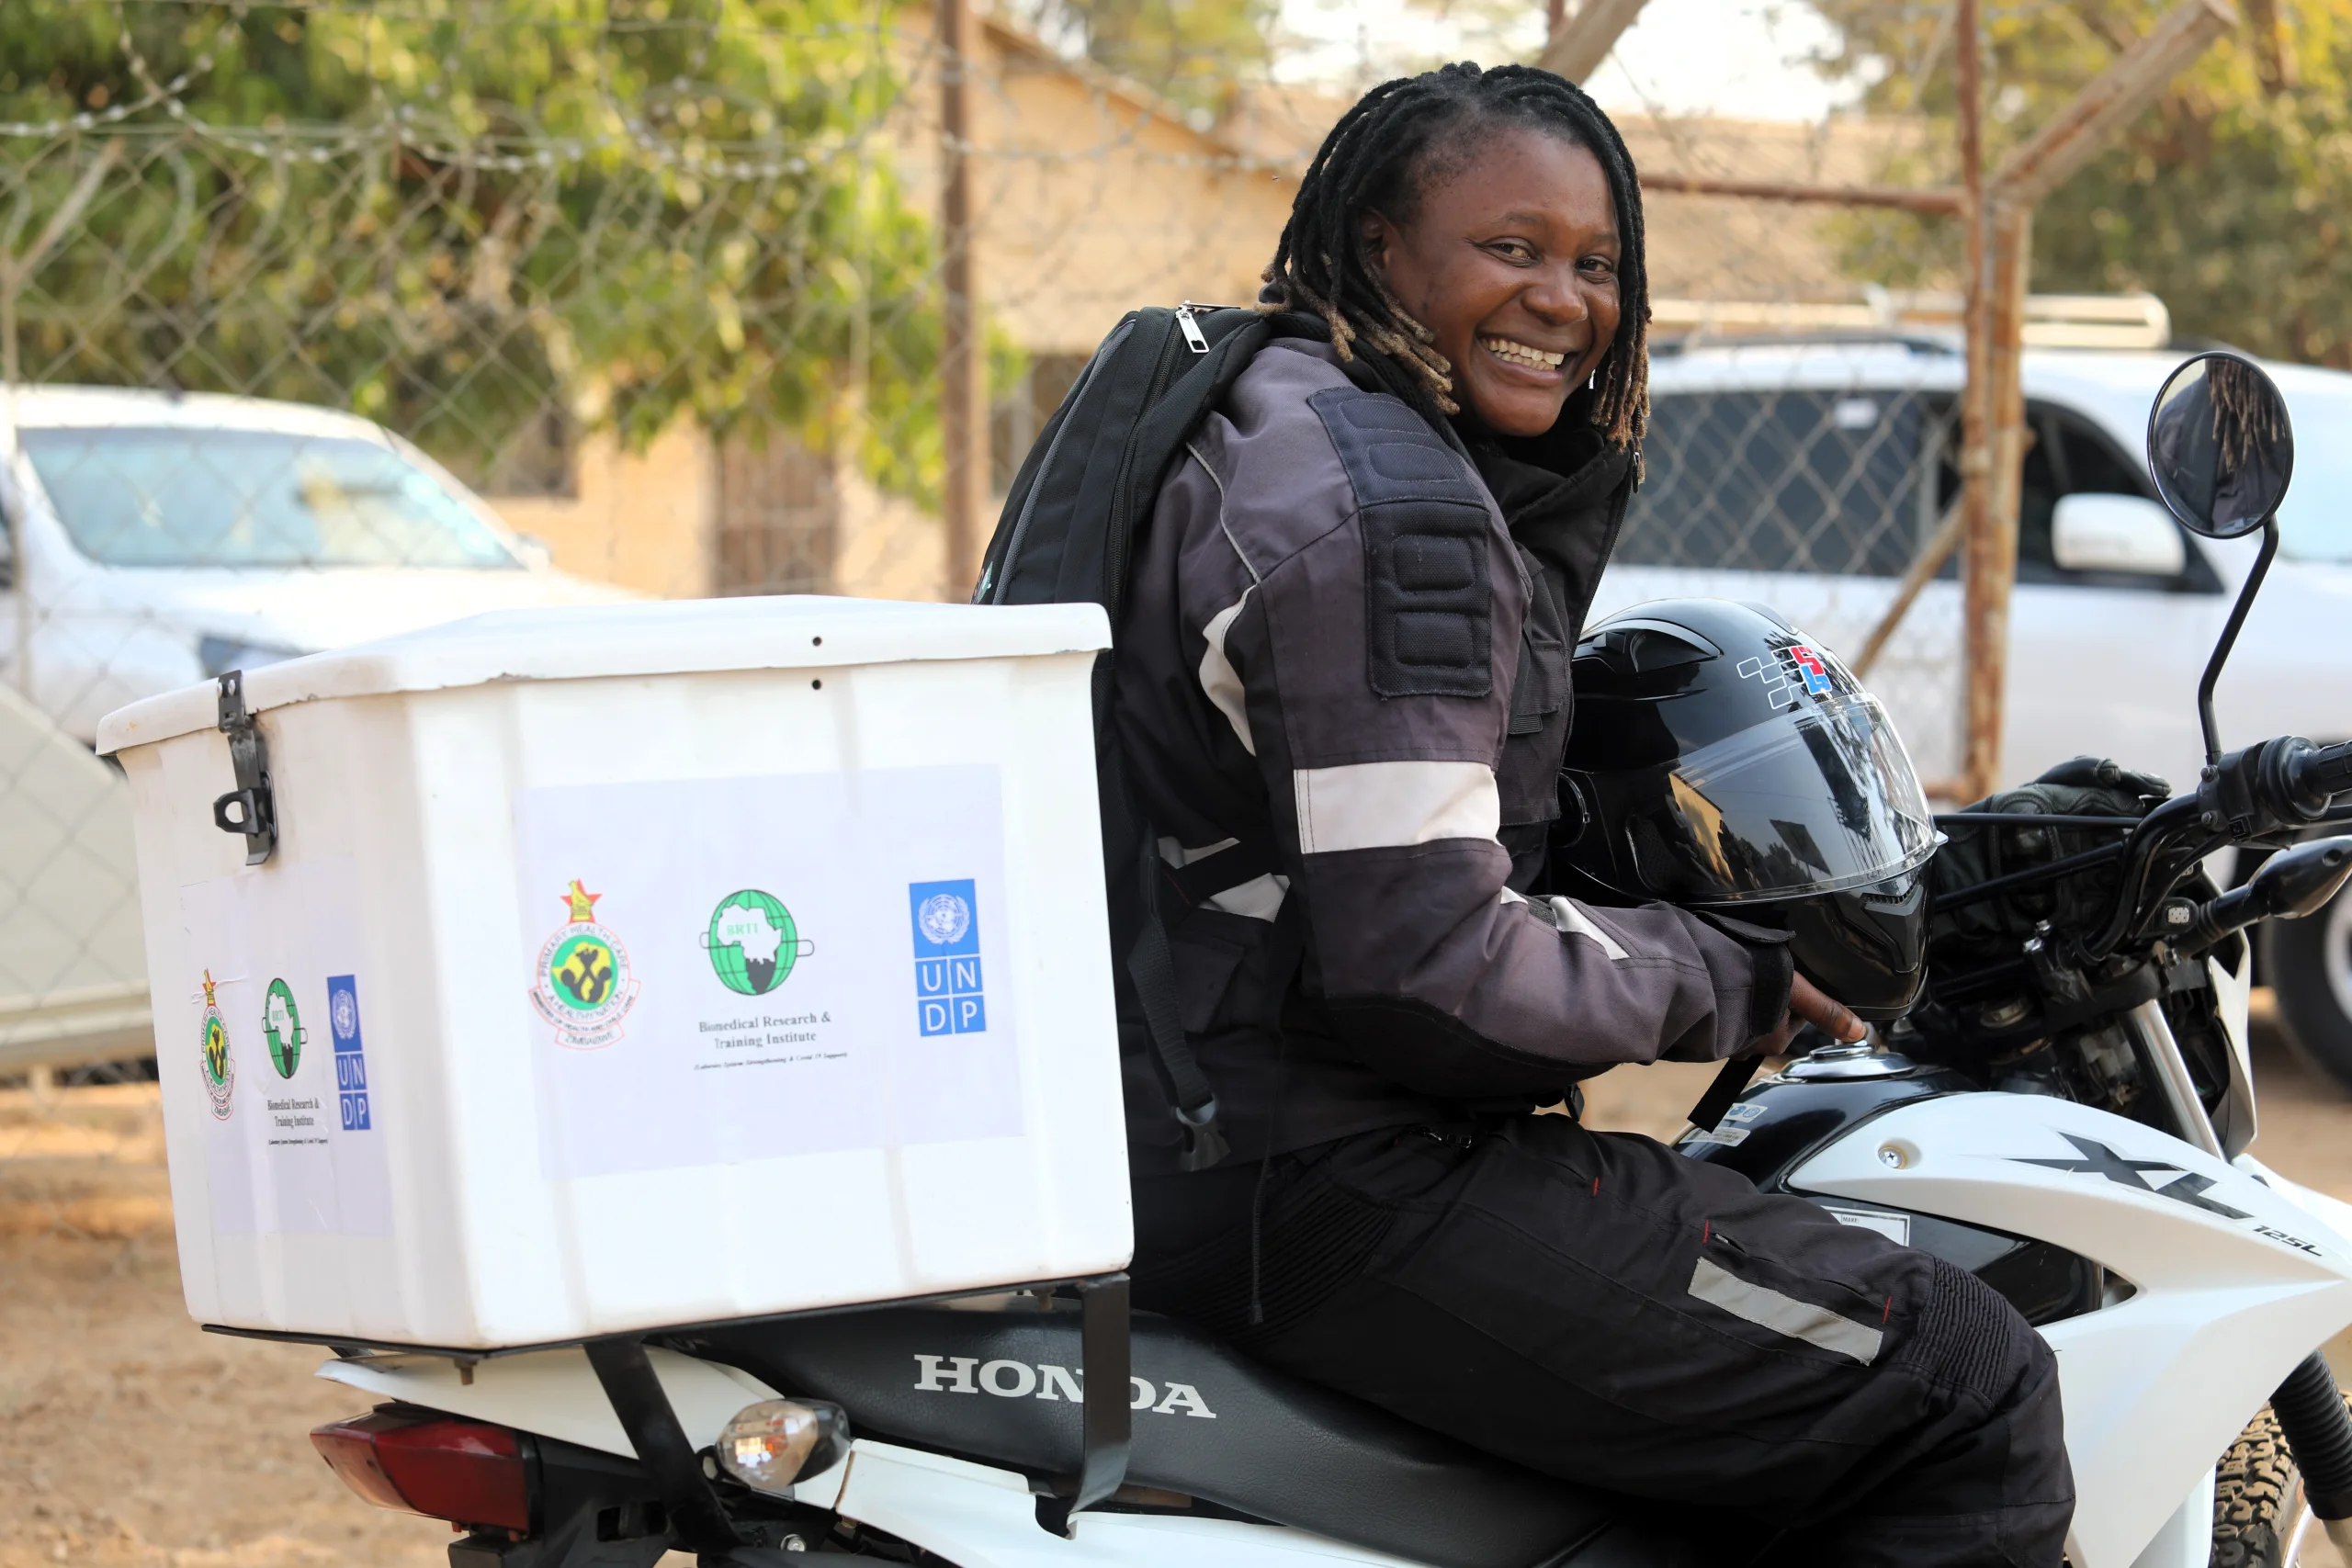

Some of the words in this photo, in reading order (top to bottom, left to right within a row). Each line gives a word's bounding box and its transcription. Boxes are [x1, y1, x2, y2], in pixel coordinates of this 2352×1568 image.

[727, 922, 758, 935] BRTI
[698, 1017, 759, 1033] Biomedical
[763, 1012, 817, 1028] Research
[820, 1010, 832, 1023] &
[714, 1035, 763, 1049] Training
[766, 1032, 817, 1045] Institute
[291, 1098, 313, 1110] Research
[275, 1115, 294, 1129] Training
[294, 1115, 314, 1126] Institute
[1843, 1216, 1860, 1224] MAKE:
[2253, 1224, 2324, 1257] 125L
